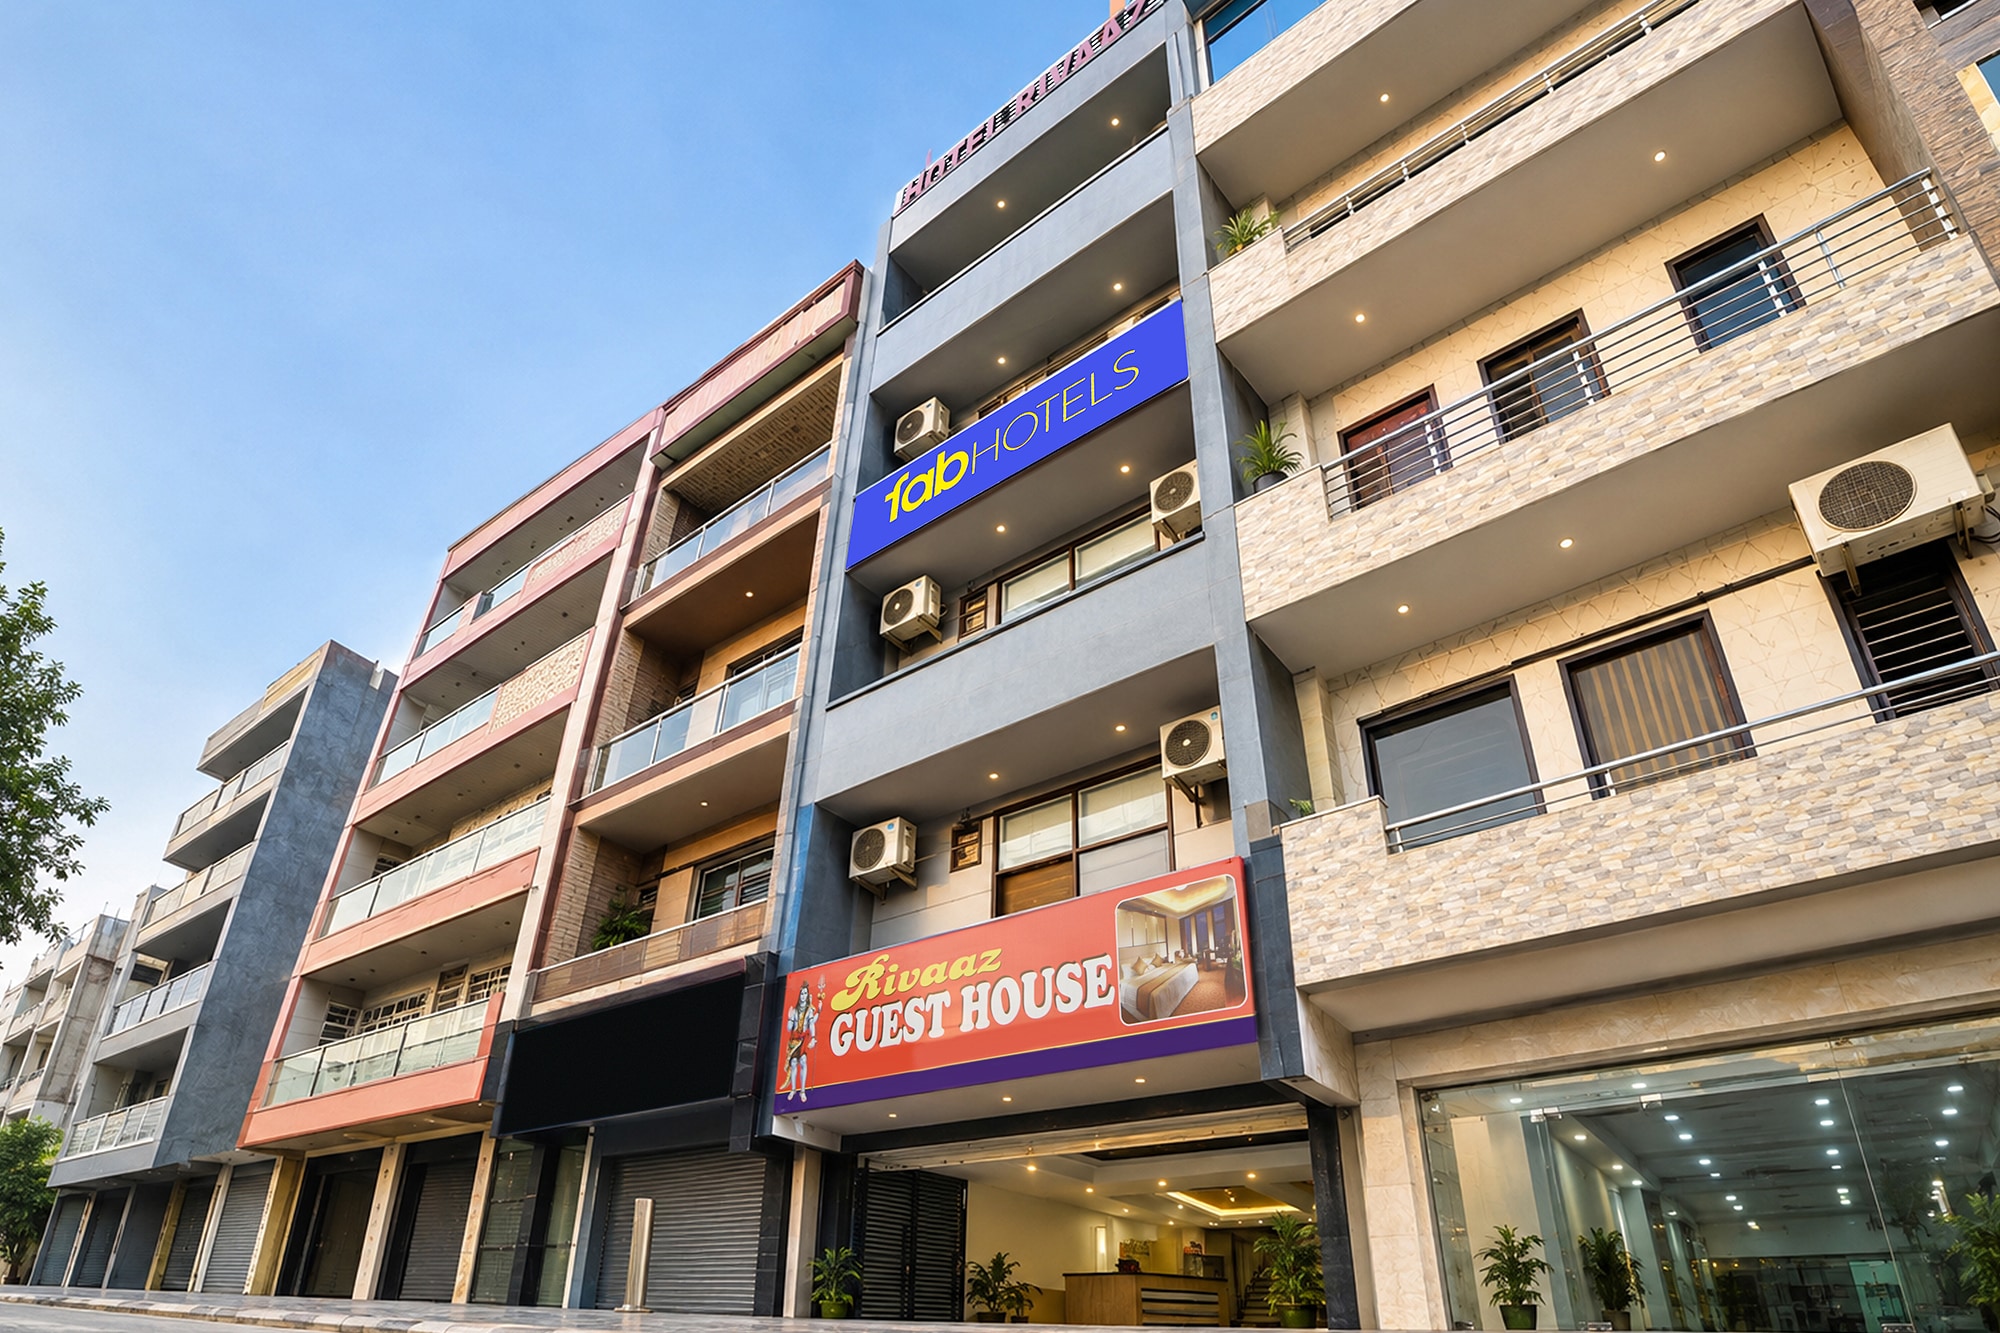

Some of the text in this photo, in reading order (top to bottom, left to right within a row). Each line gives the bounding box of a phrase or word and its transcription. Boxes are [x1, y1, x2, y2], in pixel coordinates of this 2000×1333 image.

[829, 952, 1117, 1057] GUEST HOUSE
[830, 947, 1003, 1012] Rivaaz
